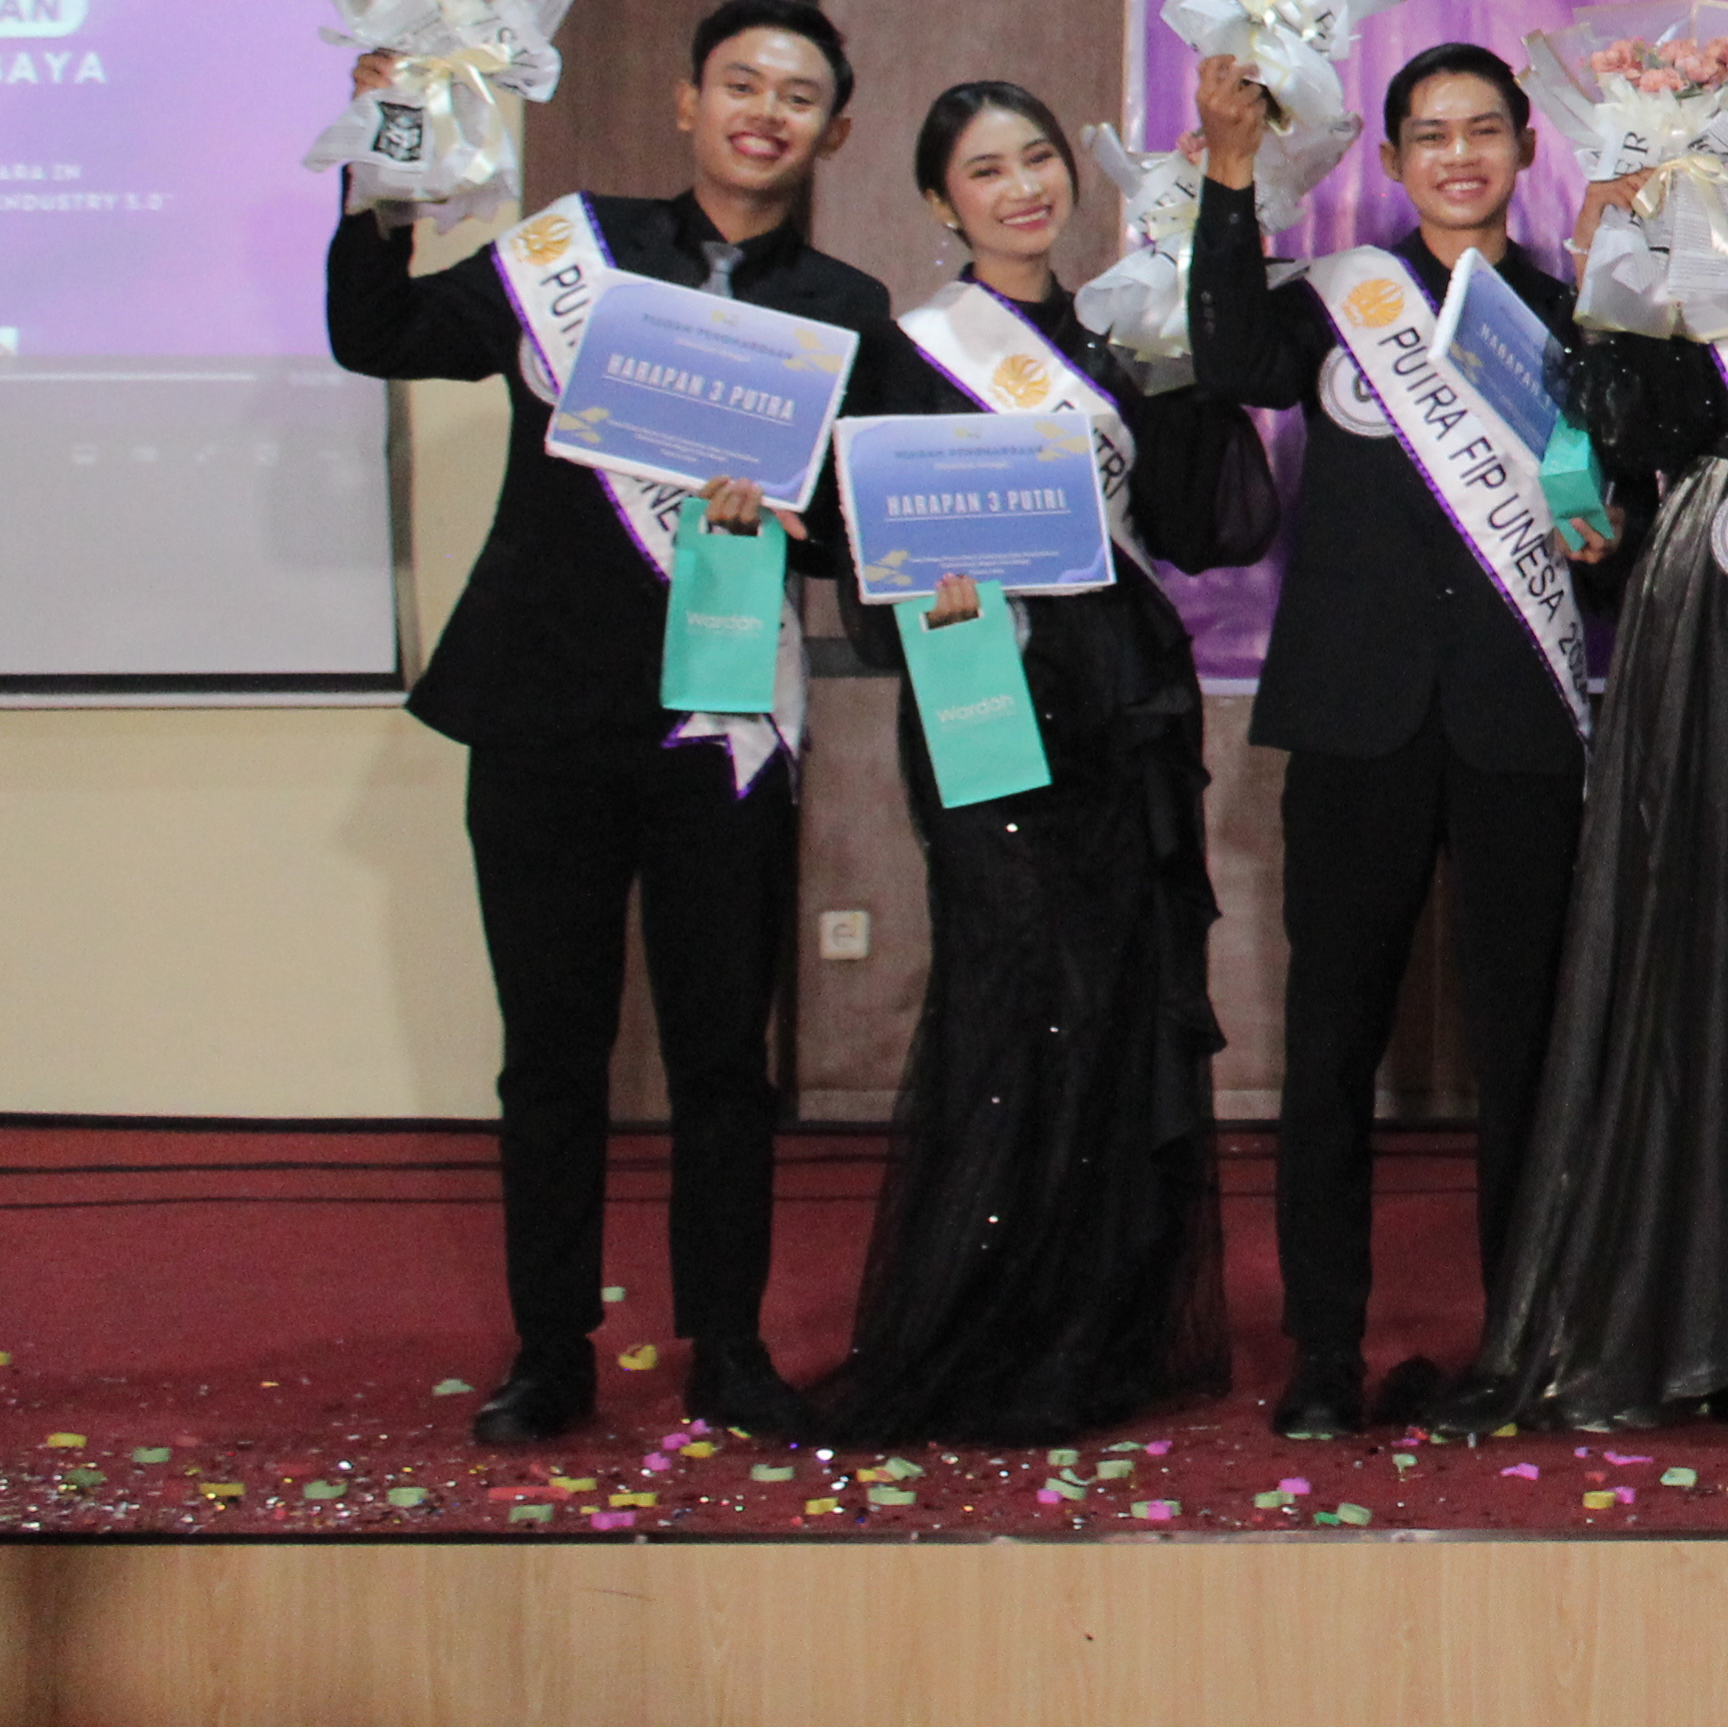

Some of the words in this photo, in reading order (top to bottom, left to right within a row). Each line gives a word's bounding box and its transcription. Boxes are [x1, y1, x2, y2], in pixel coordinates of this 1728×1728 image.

[607, 352, 705, 400] HARAPAN
[709, 381, 723, 402] 3
[729, 384, 796, 421] PUTRA
[886, 491, 979, 517] HARAPAN
[988, 489, 1001, 512] 3
[1007, 487, 1067, 511] PUTRI
[1448, 435, 1507, 494] FIP
[1487, 493, 1570, 622] UNESA
[937, 694, 1015, 722] Wardah
